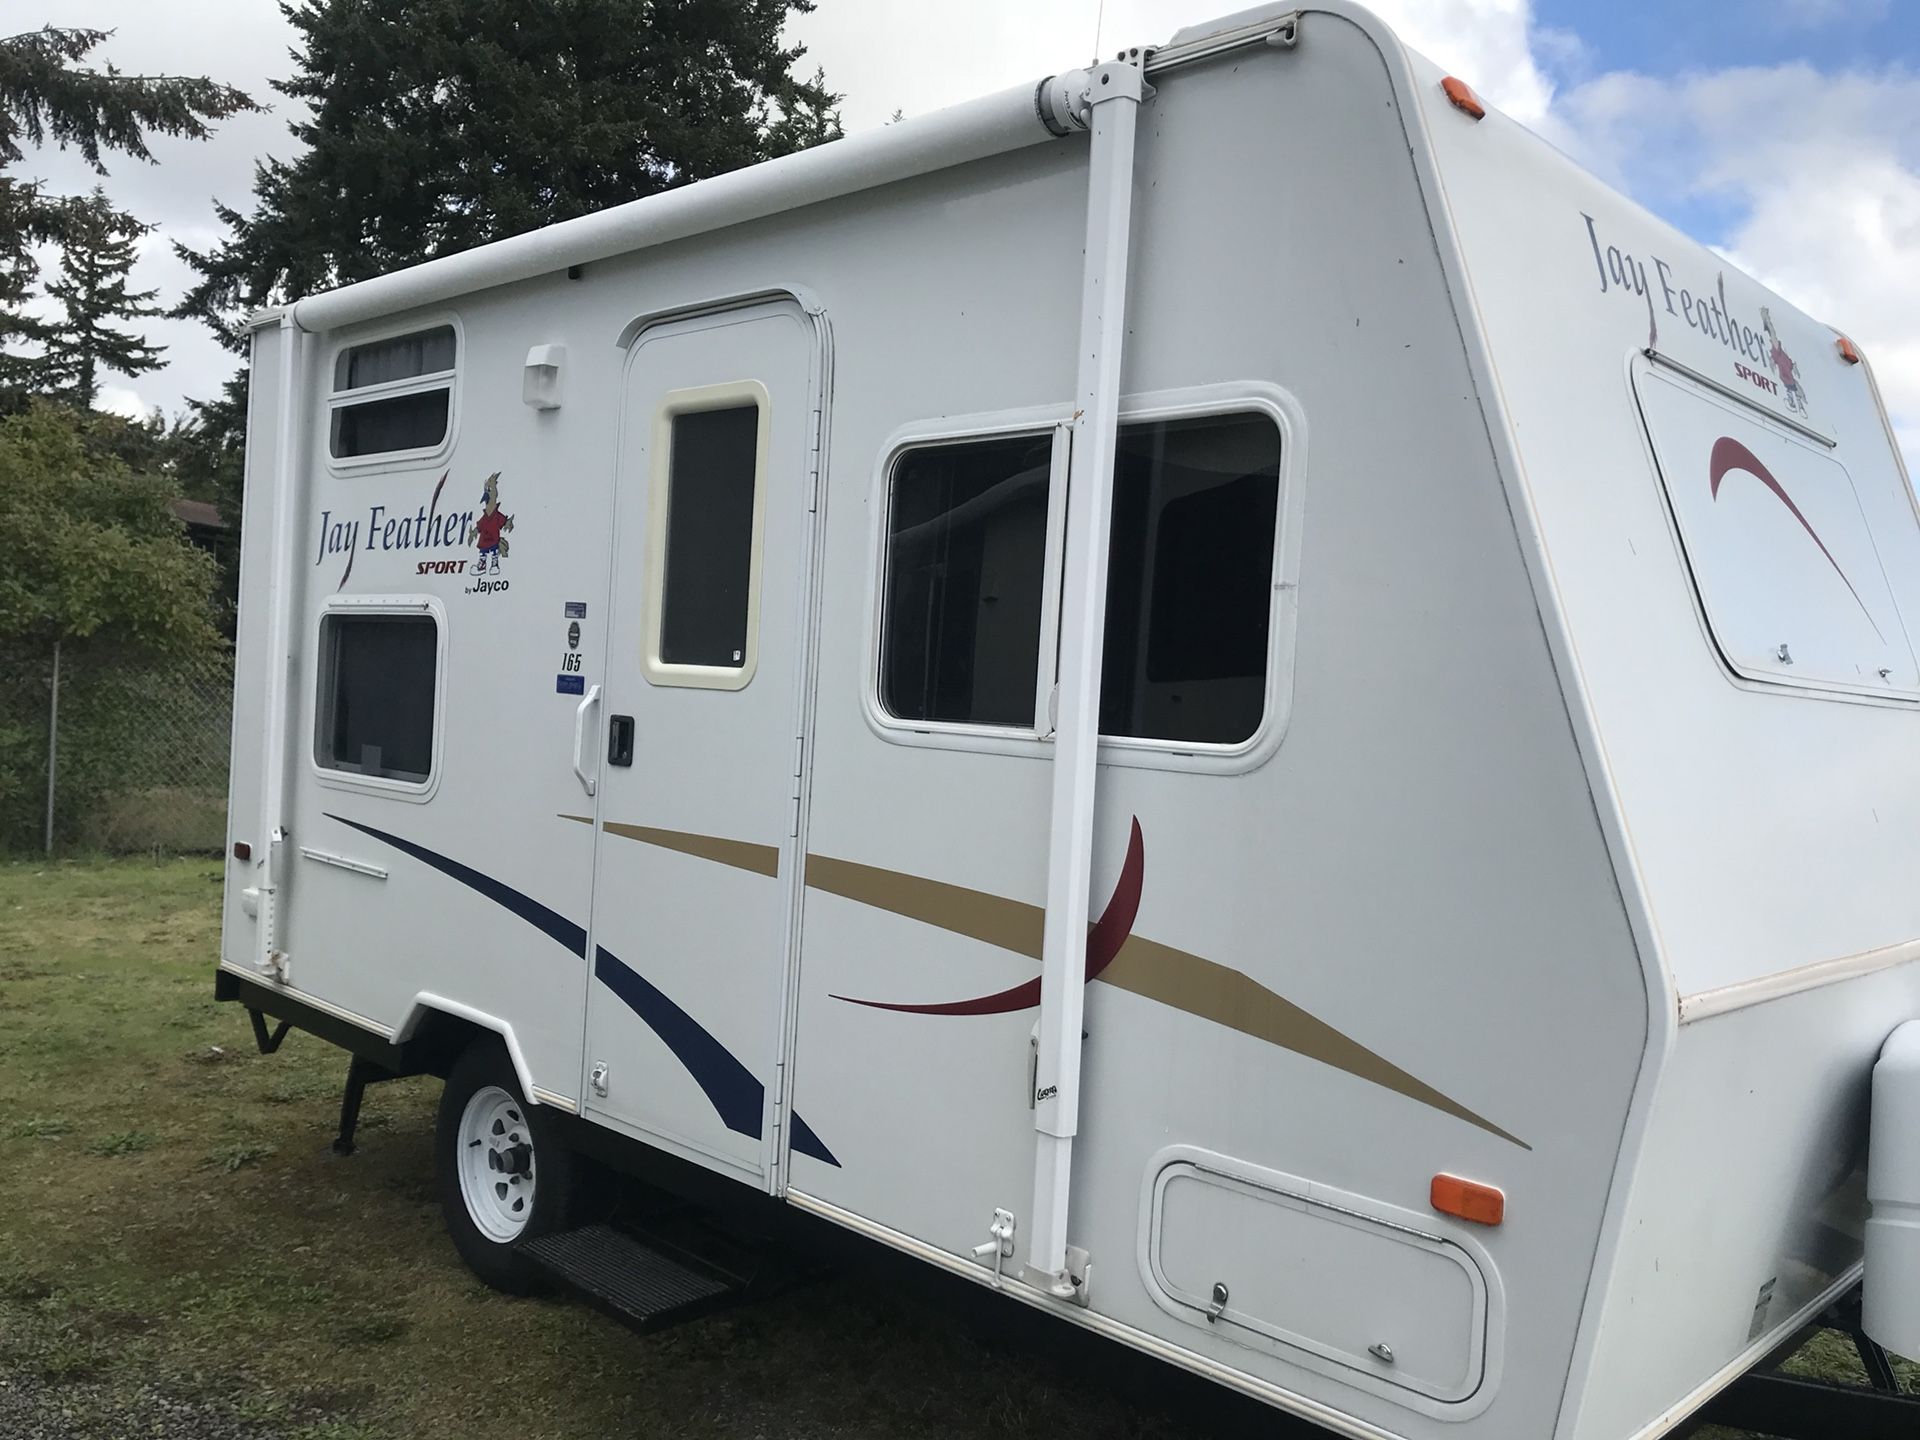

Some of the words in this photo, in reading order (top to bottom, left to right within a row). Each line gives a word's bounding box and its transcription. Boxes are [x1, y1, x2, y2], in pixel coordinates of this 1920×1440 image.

[1579, 211, 1657, 350] Jay
[1651, 255, 1768, 368] Feather
[1734, 362, 1779, 396] SPORT
[315, 510, 359, 592] Jay
[365, 468, 473, 551] Feather
[415, 560, 468, 575] SPORT
[472, 577, 509, 595] Jayco
[561, 652, 582, 672] 165
